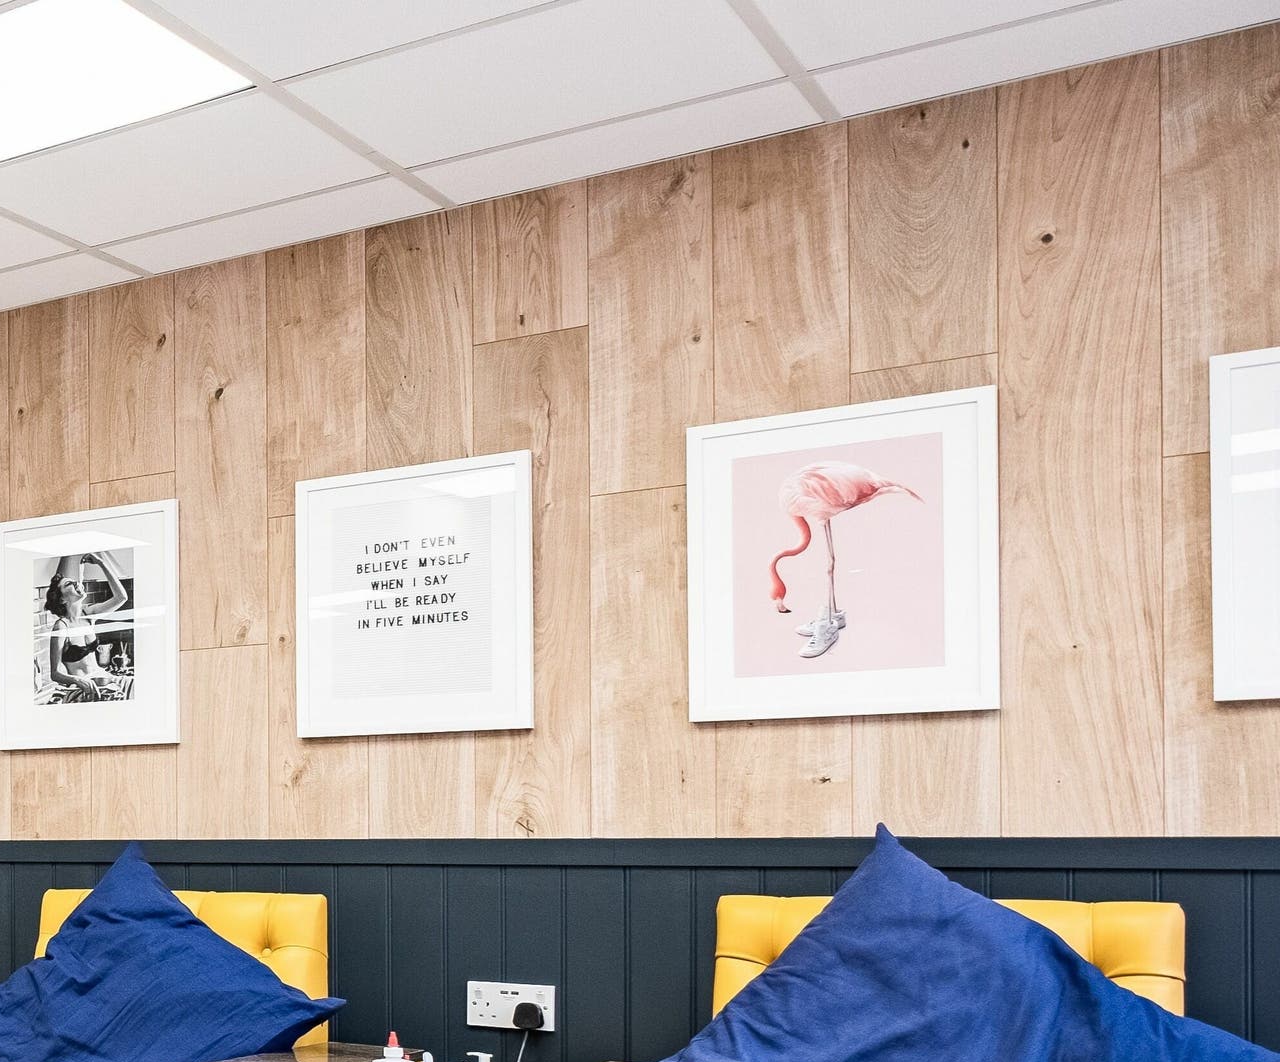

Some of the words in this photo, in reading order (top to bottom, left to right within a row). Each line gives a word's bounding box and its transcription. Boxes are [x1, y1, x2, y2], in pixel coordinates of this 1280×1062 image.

[365, 545, 369, 555] I
[374, 540, 410, 554] DON'T
[421, 536, 456, 549] EVEN
[356, 559, 408, 575] BELIEVE
[418, 552, 471, 568] MYSELF
[371, 578, 404, 591] WHEN
[413, 577, 416, 587] I
[424, 574, 448, 586] SAY
[366, 600, 387, 610] I'LL
[395, 597, 409, 608] BE
[416, 592, 456, 606] READY
[358, 618, 370, 630] IN
[376, 616, 403, 628] FIVE
[412, 611, 469, 625] MINUTES
